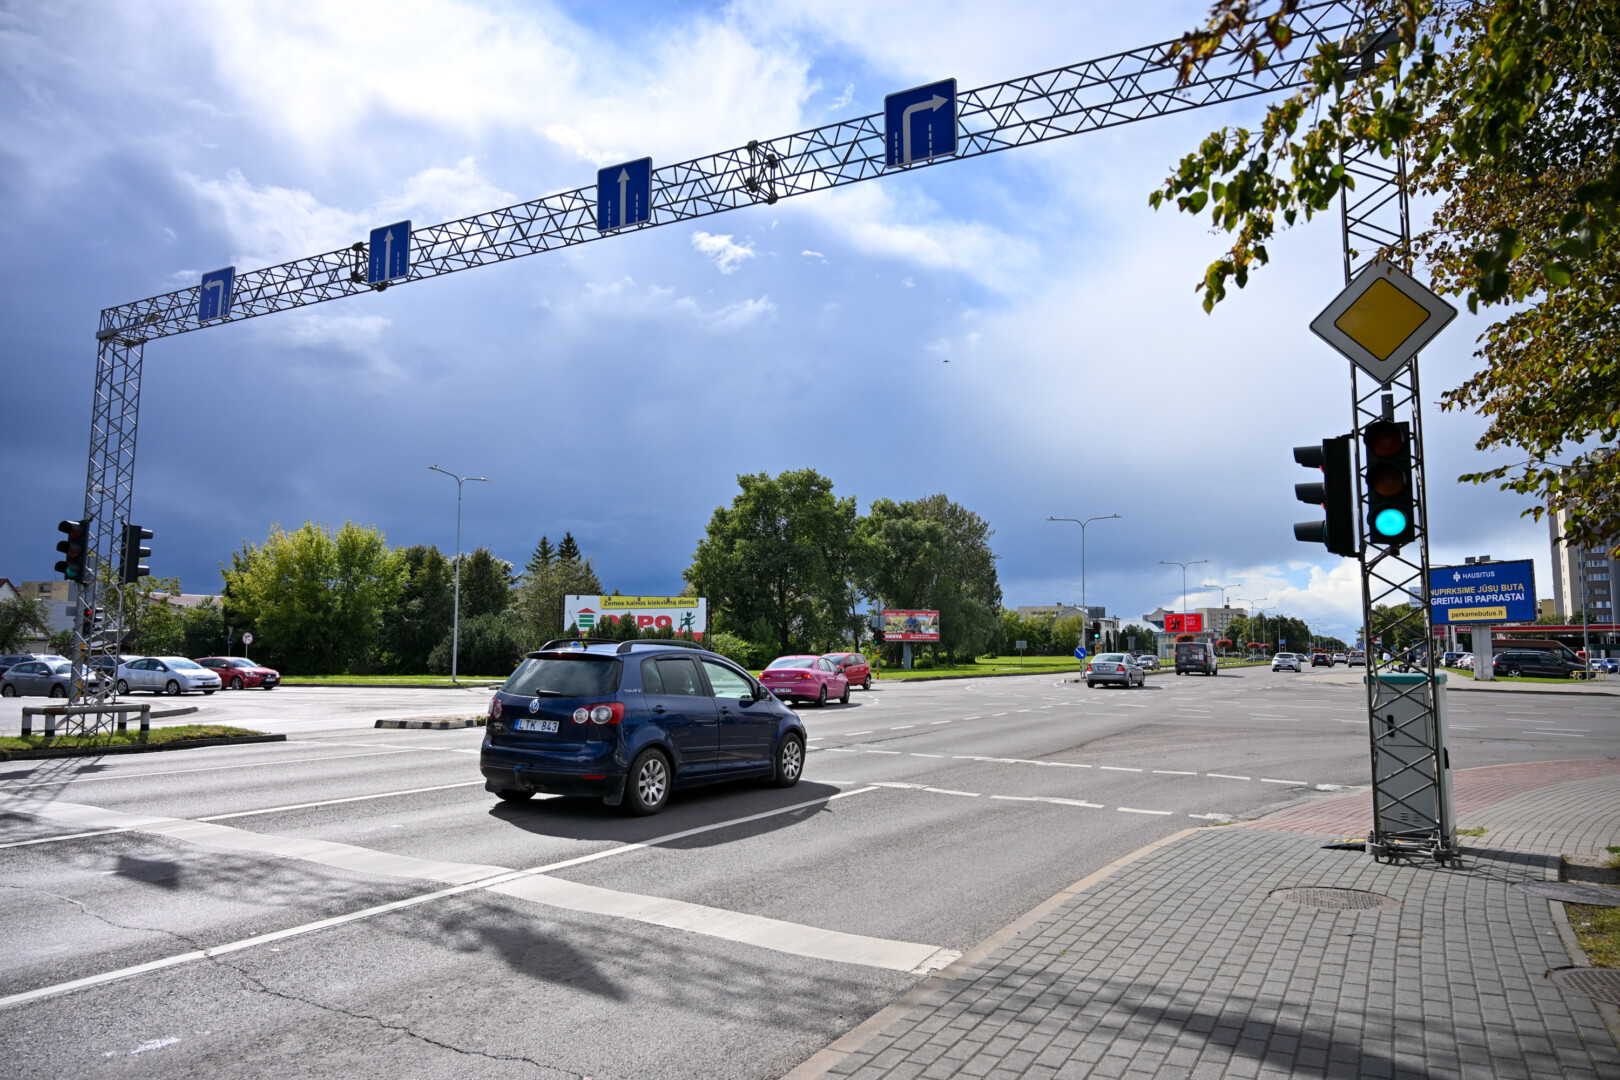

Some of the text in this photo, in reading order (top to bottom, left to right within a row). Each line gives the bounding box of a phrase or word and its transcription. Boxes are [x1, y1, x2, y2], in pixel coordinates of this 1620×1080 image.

[1462, 570, 1495, 579] HAUSITUS
[1477, 583, 1499, 593] JŪSŲ
[1501, 583, 1525, 592] BUTĄ
[1430, 596, 1463, 605] GREITAI
[1475, 593, 1525, 603] PAPRASTAI
[1451, 610, 1503, 618] perkamebutus.lt
[601, 614, 673, 629] PO
[519, 719, 558, 732] LTK 843
